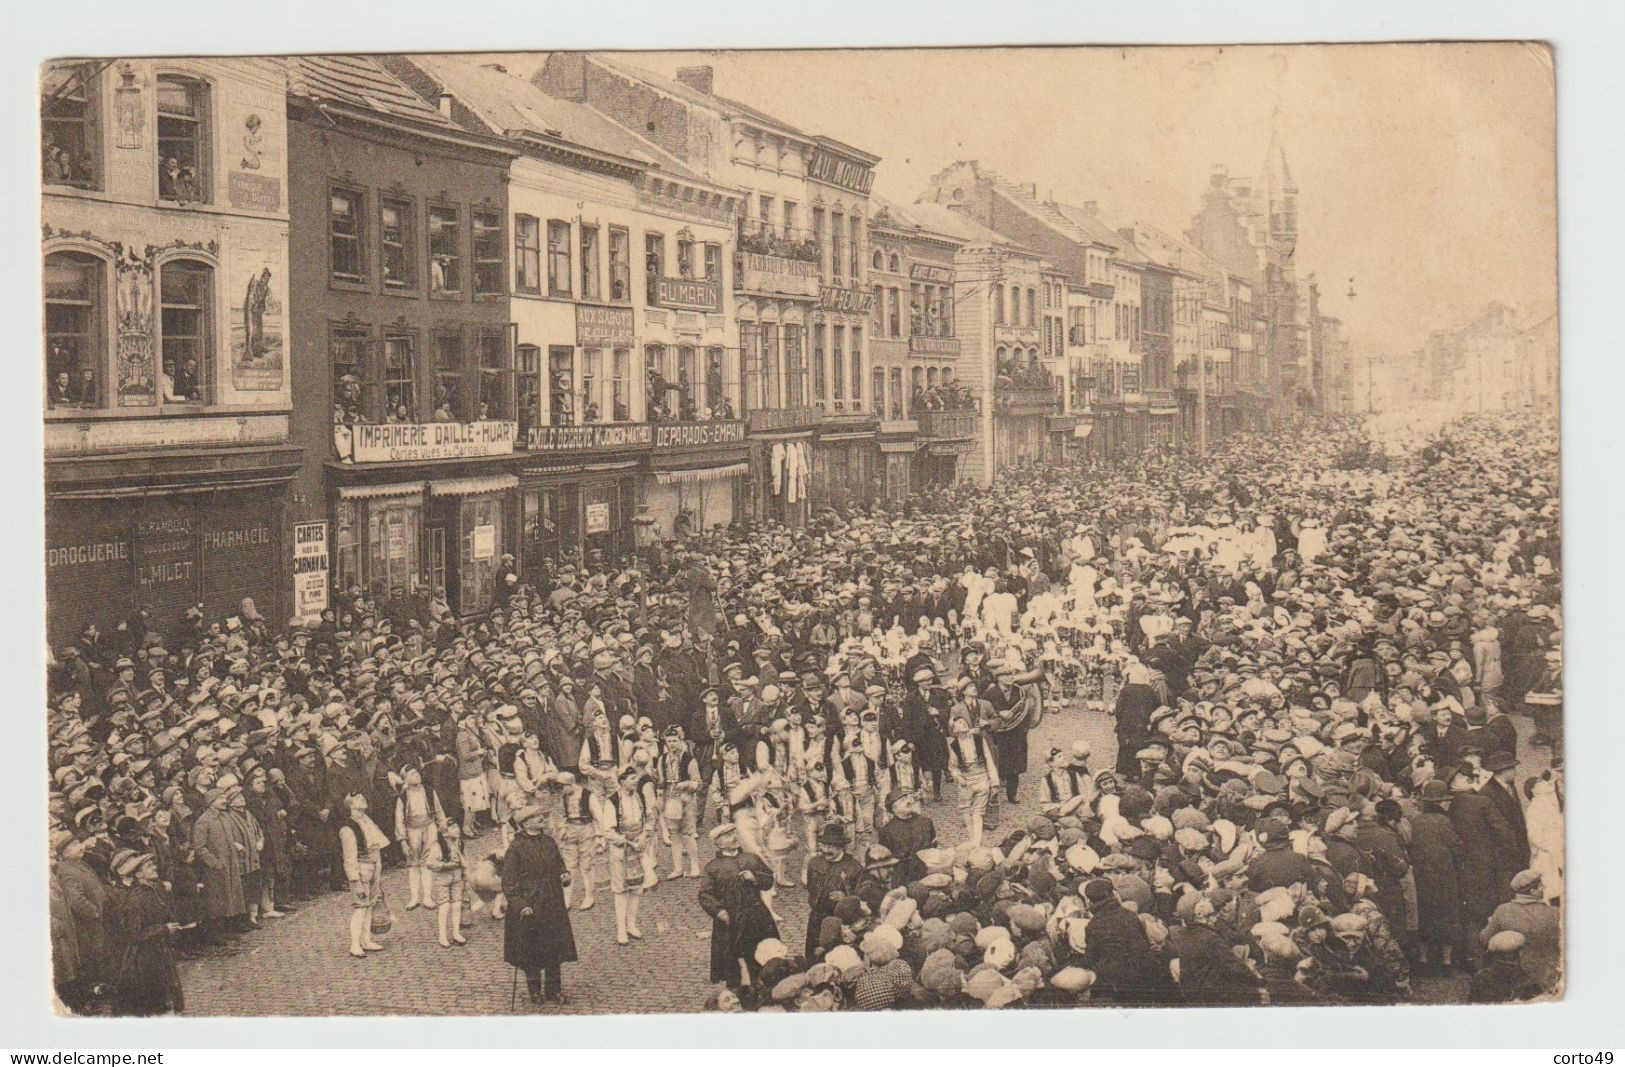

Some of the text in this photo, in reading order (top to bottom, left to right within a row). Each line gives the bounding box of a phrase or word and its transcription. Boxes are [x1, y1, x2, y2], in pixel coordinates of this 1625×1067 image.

[812, 153, 875, 193] AU MOULIN
[660, 282, 717, 305] AU MARIN
[578, 308, 633, 327] AUX SABOTS
[359, 425, 428, 449] IMPRIMERIE
[527, 427, 555, 450] EMILE
[390, 447, 419, 461] Cartes
[204, 527, 270, 549] PHARMACIE
[297, 525, 324, 544] CARTES
[49, 542, 129, 567] DROGUERIE
[293, 554, 328, 575] CARNAVAL
